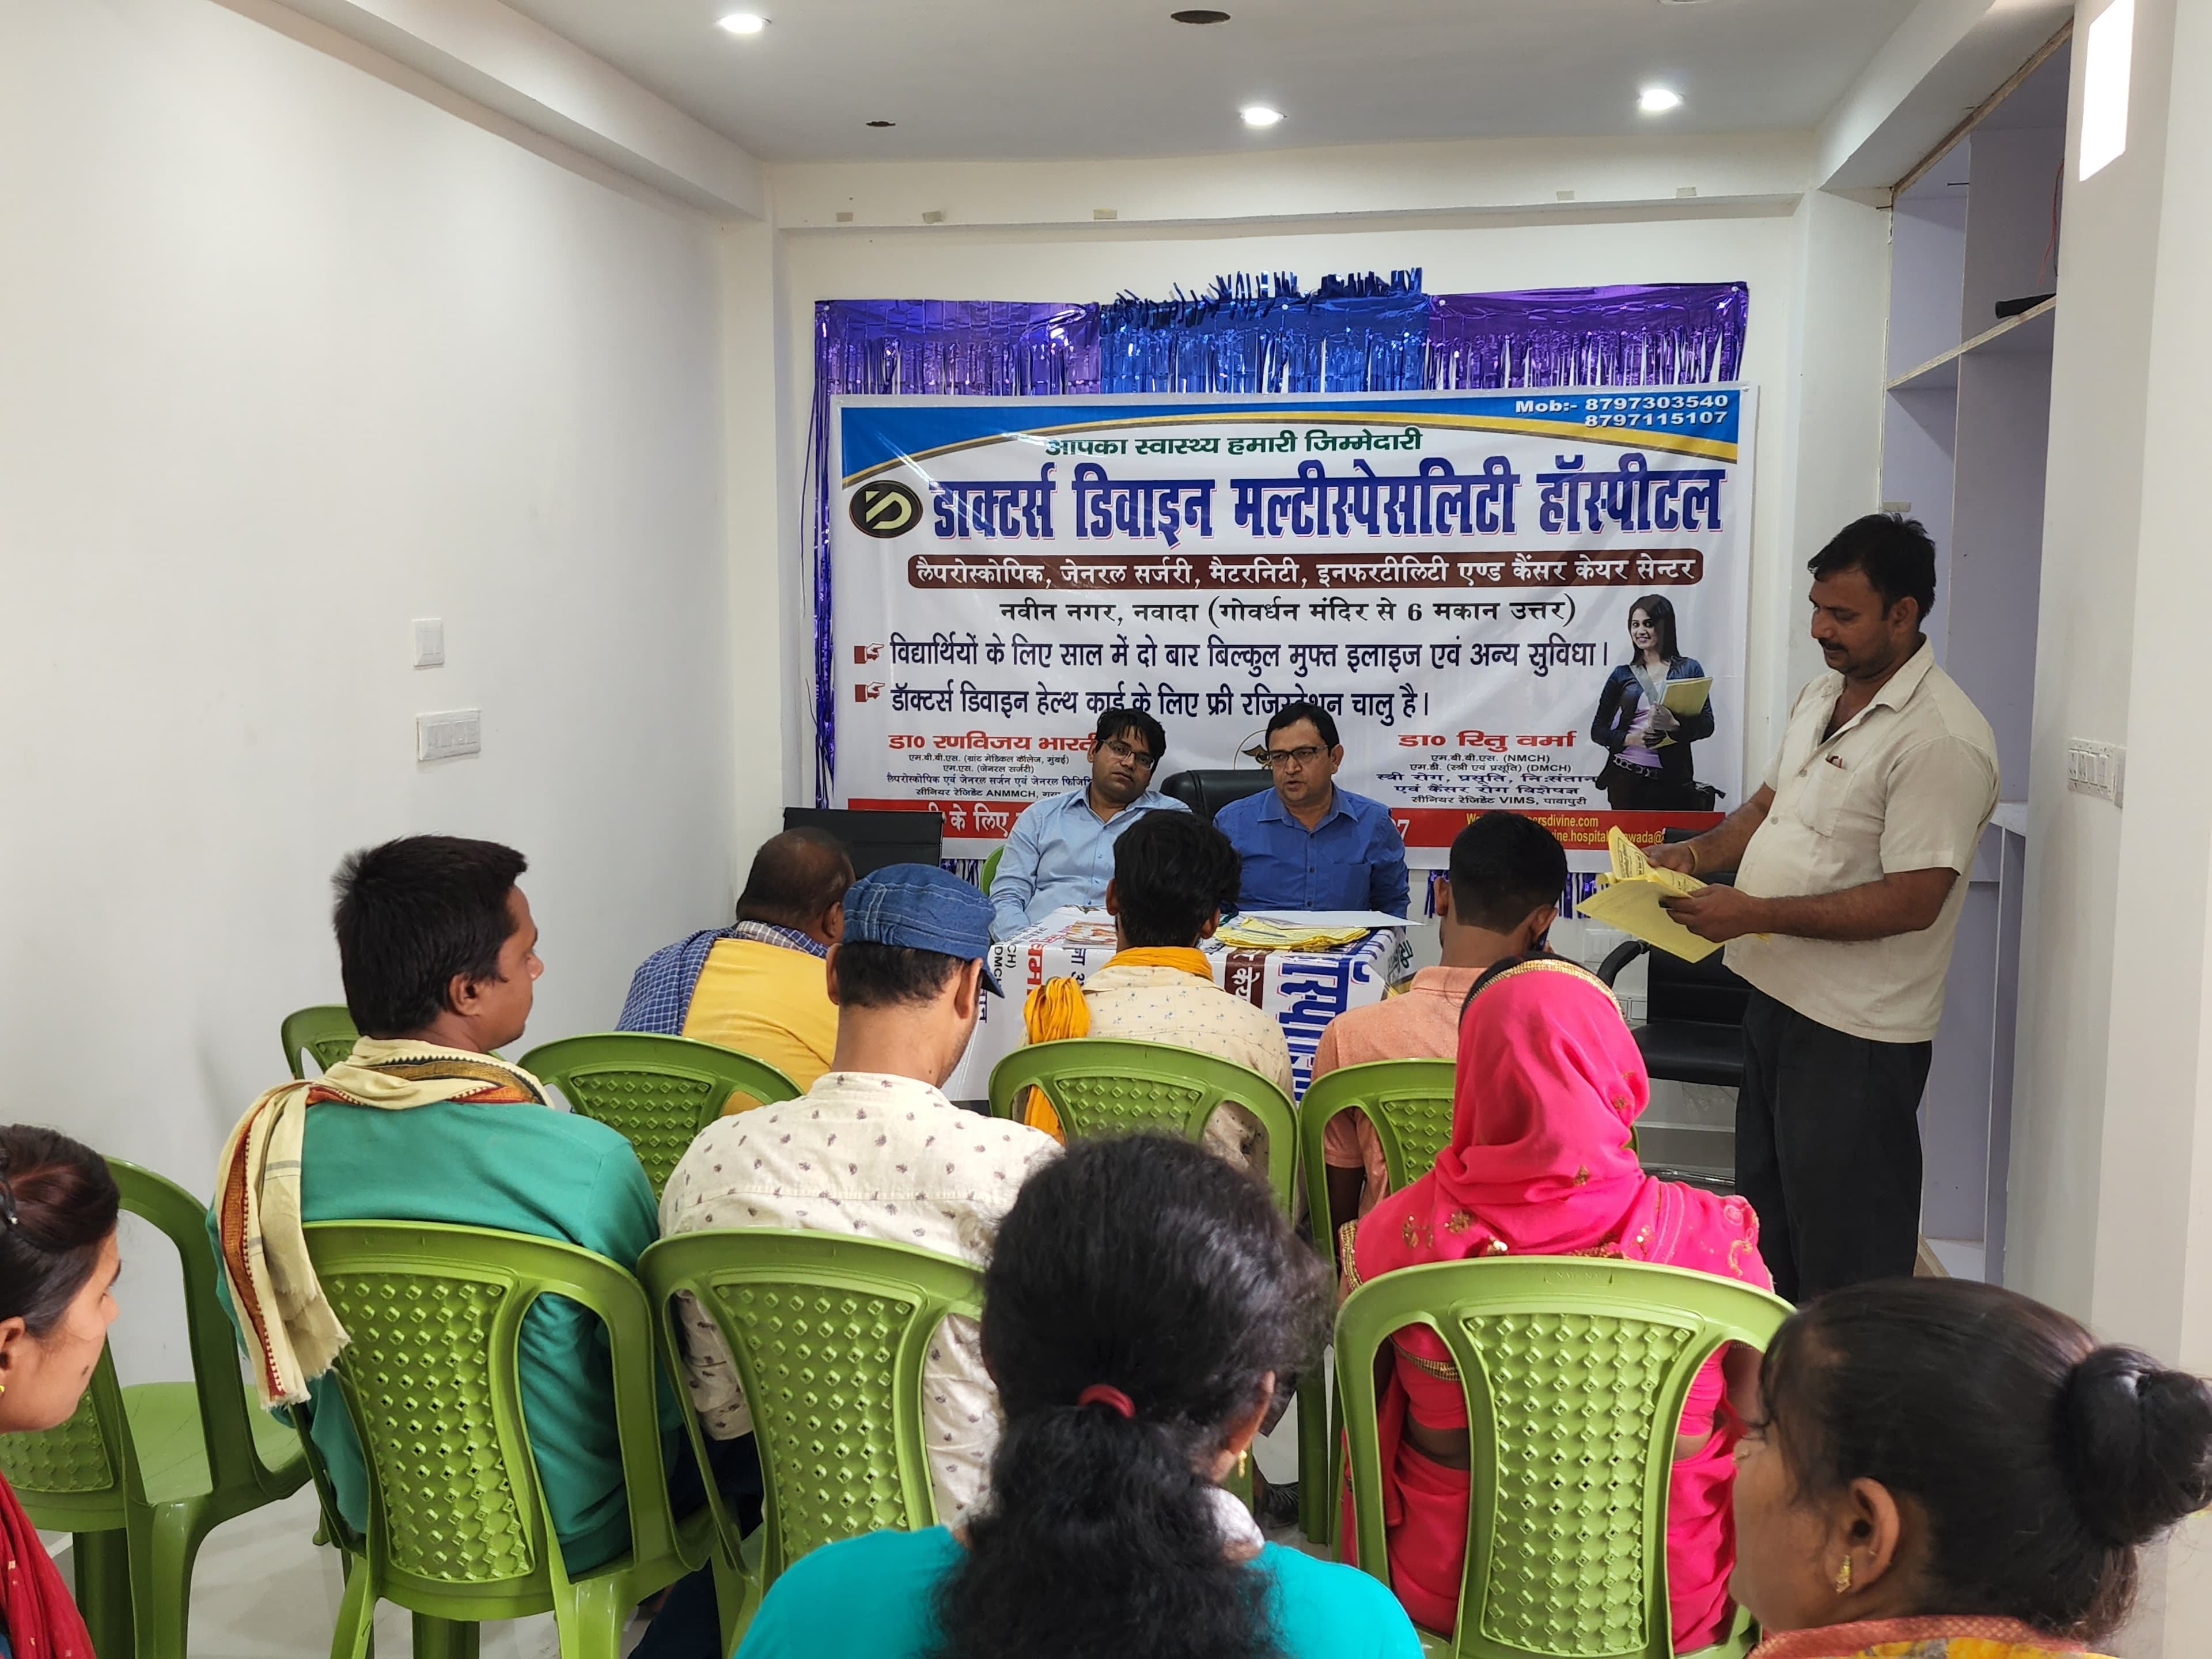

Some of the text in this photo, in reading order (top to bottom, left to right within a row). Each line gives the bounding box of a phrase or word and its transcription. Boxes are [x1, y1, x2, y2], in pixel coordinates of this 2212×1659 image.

[1516, 395, 1728, 413] Mob:- 8797303540
[1584, 411, 1728, 427] 8797115107
[1045, 427, 1423, 455] आपका स्वास्थ्य हमारी जिम्मेदारी
[929, 452, 1729, 550] डाक्टर्स डिवाइन मल्टीस्पेसलिटी हॉस्पीटल
[916, 552, 1696, 589] लैपरोस्कोपिक, जेनरल सर्जरी, मैटरनिटी, इनफरटीलिटी एण्ड कैंसर केयर सेन्टर
[999, 593, 1576, 629] नवीन नगर, नवादा (गोवर्धन मंदिर से 6 मकान उत्तर)
[889, 631, 979, 665] विद्यार्थियों
[985, 632, 1005, 665] के
[1012, 633, 1052, 668] लिए
[1059, 643, 1103, 666] साल
[1110, 634, 1129, 666] में
[1136, 634, 1158, 668] दो
[1164, 644, 1200, 666] बार
[1207, 634, 1282, 677] बिल्कुल
[1288, 644, 1338, 678] मुफ्त
[1345, 643, 1422, 673] इलाइज
[1430, 635, 1462, 669] एवं
[1470, 643, 1520, 666] अन्य
[890, 679, 954, 712] डॉक्टर्स
[960, 680, 1029, 719] डिवाइन
[1036, 681, 1078, 715] हेल्थ
[1085, 681, 1126, 714] कार्ड
[1131, 682, 1152, 714] के
[1158, 682, 1199, 717] लिए
[1206, 683, 1234, 715] फ्री
[1351, 693, 1395, 726] चालु
[932, 730, 1033, 750] रणविजय
[1456, 730, 1509, 753] रितु
[1516, 730, 1578, 747] वर्मा
[1503, 755, 1550, 764] (NMCH)
[1527, 764, 1571, 774] (DMCH)
[943, 774, 956, 786] एवं
[959, 774, 987, 785] जेनरल
[989, 774, 1012, 785] सर्जन
[1014, 775, 1028, 787] एवं
[1031, 775, 1059, 786] जेनरल
[1376, 771, 1405, 781] स्त्री
[986, 790, 1039, 800] ANMMCH,
[1393, 783, 1421, 794] एवं
[1427, 783, 1470, 793] कैंसर
[1476, 784, 1510, 794] रोग
[1499, 797, 1539, 806] VIMS,
[949, 802, 1010, 838] के लिए
